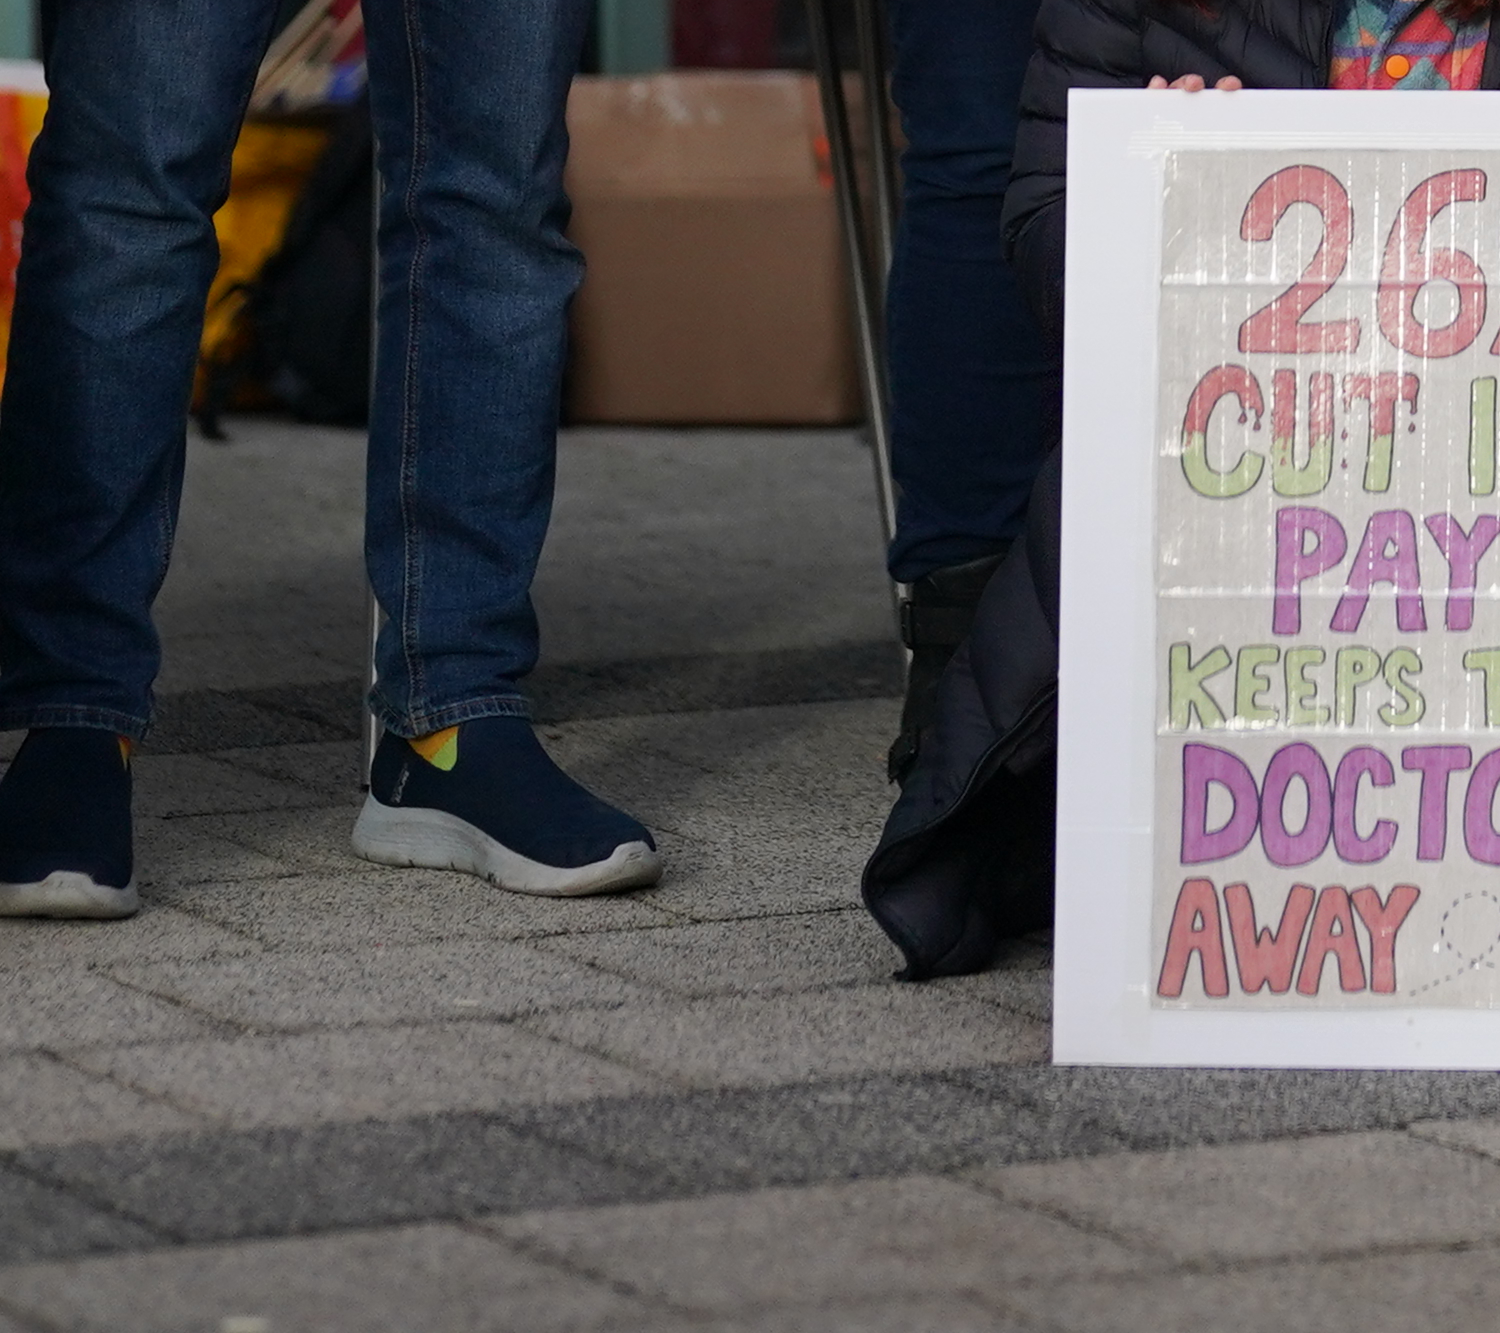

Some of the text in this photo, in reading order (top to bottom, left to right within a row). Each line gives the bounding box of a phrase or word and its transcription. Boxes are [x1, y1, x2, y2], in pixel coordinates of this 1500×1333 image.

[1180, 364, 1419, 500] CUT
[1167, 642, 1426, 730] KEEPS
[1156, 876, 1421, 999] AWAY
